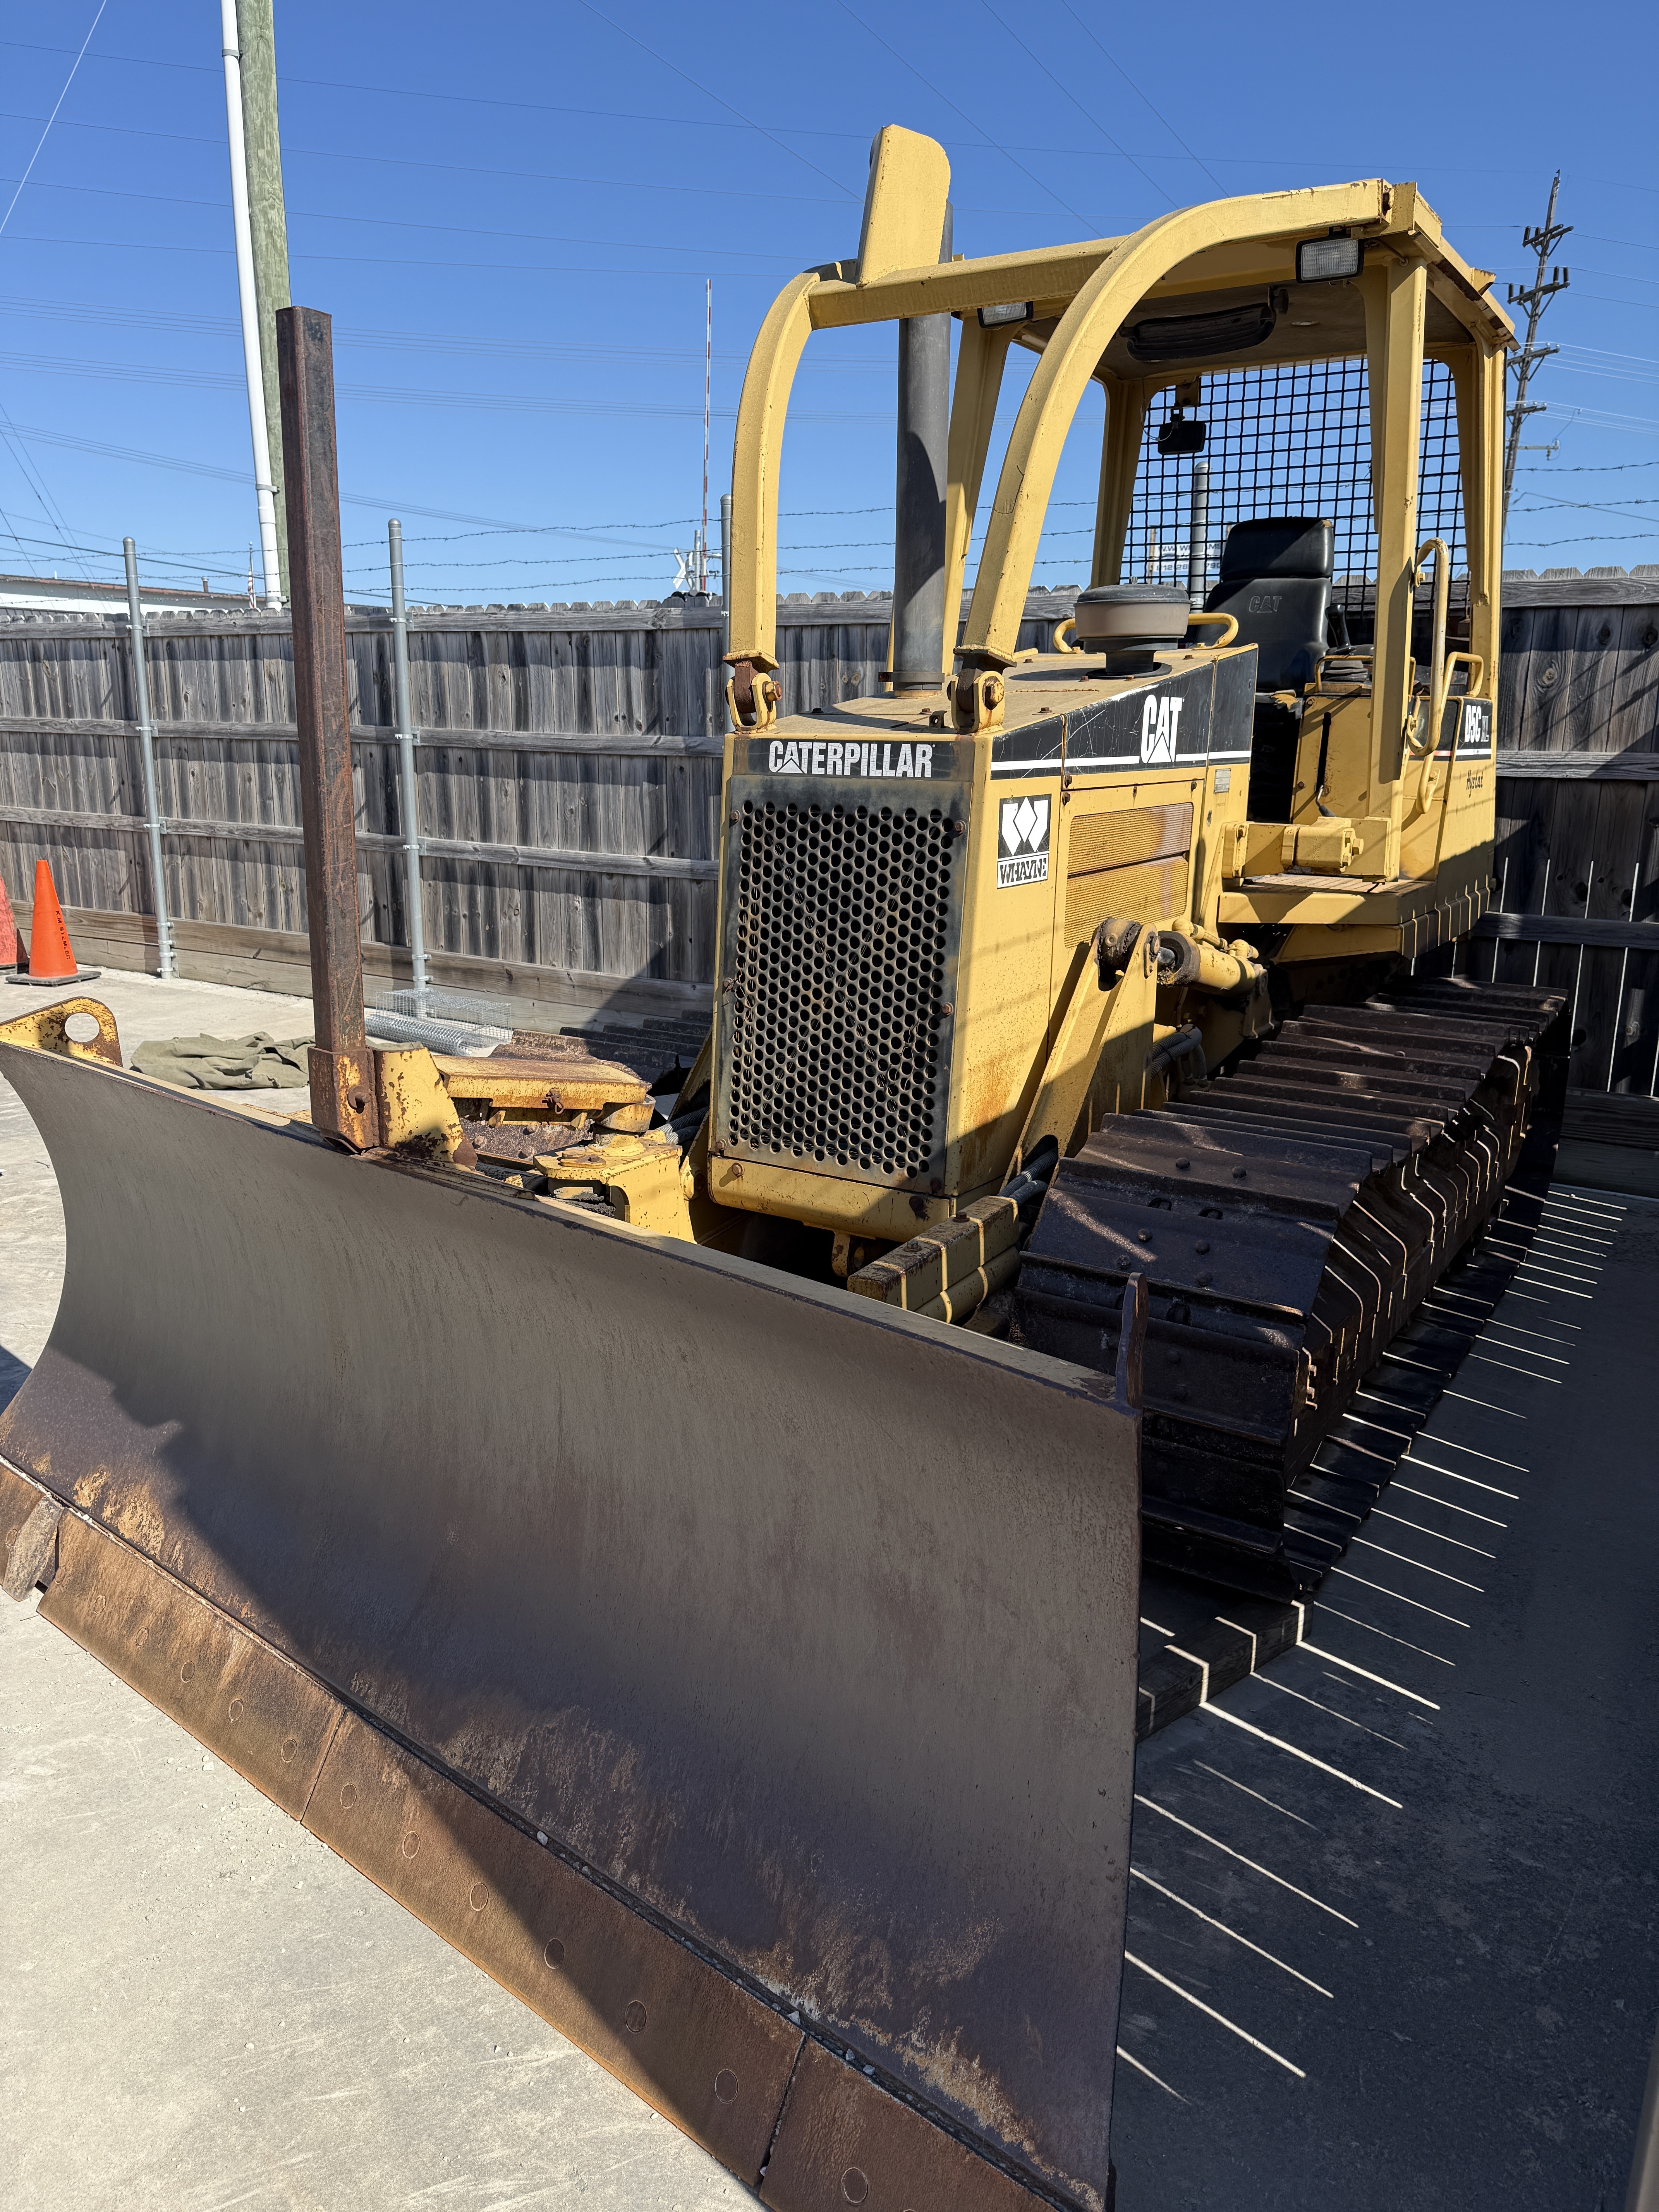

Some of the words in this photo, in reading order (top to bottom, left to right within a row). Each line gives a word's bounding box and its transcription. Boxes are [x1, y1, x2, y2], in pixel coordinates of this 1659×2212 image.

[1249, 595, 1282, 613] CAT
[1141, 694, 1182, 764] CAT
[1464, 705, 1482, 743] D5C
[769, 740, 933, 778] CATERPILLAR
[1466, 769, 1483, 798] Hystat
[1000, 858, 1047, 884] WHAYNE
